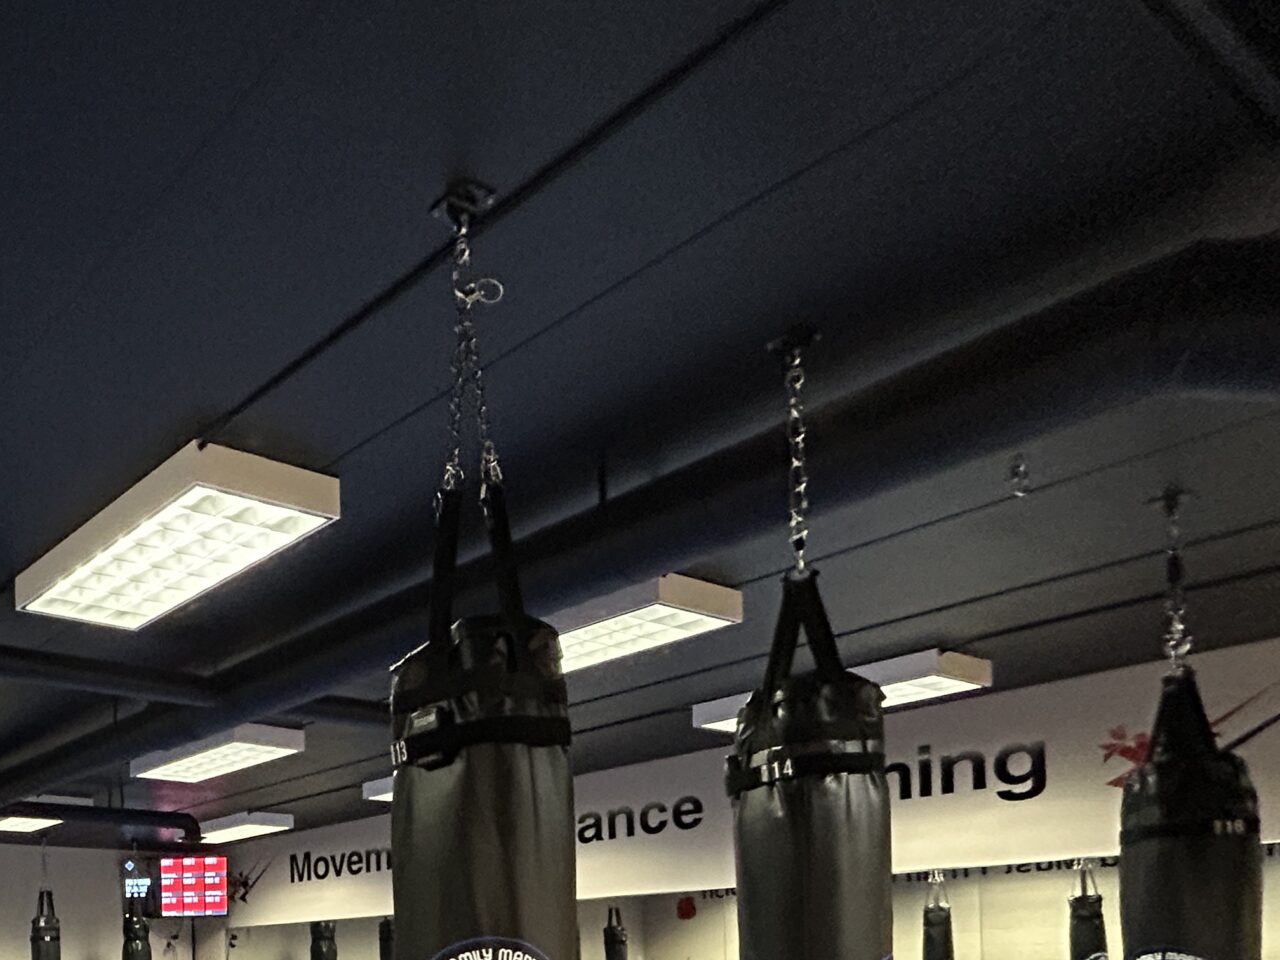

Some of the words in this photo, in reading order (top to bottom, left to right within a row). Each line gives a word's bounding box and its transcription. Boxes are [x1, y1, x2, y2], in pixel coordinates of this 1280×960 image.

[290, 848, 393, 883] Movem
[577, 795, 704, 844] ance
[885, 740, 1047, 802] ning
